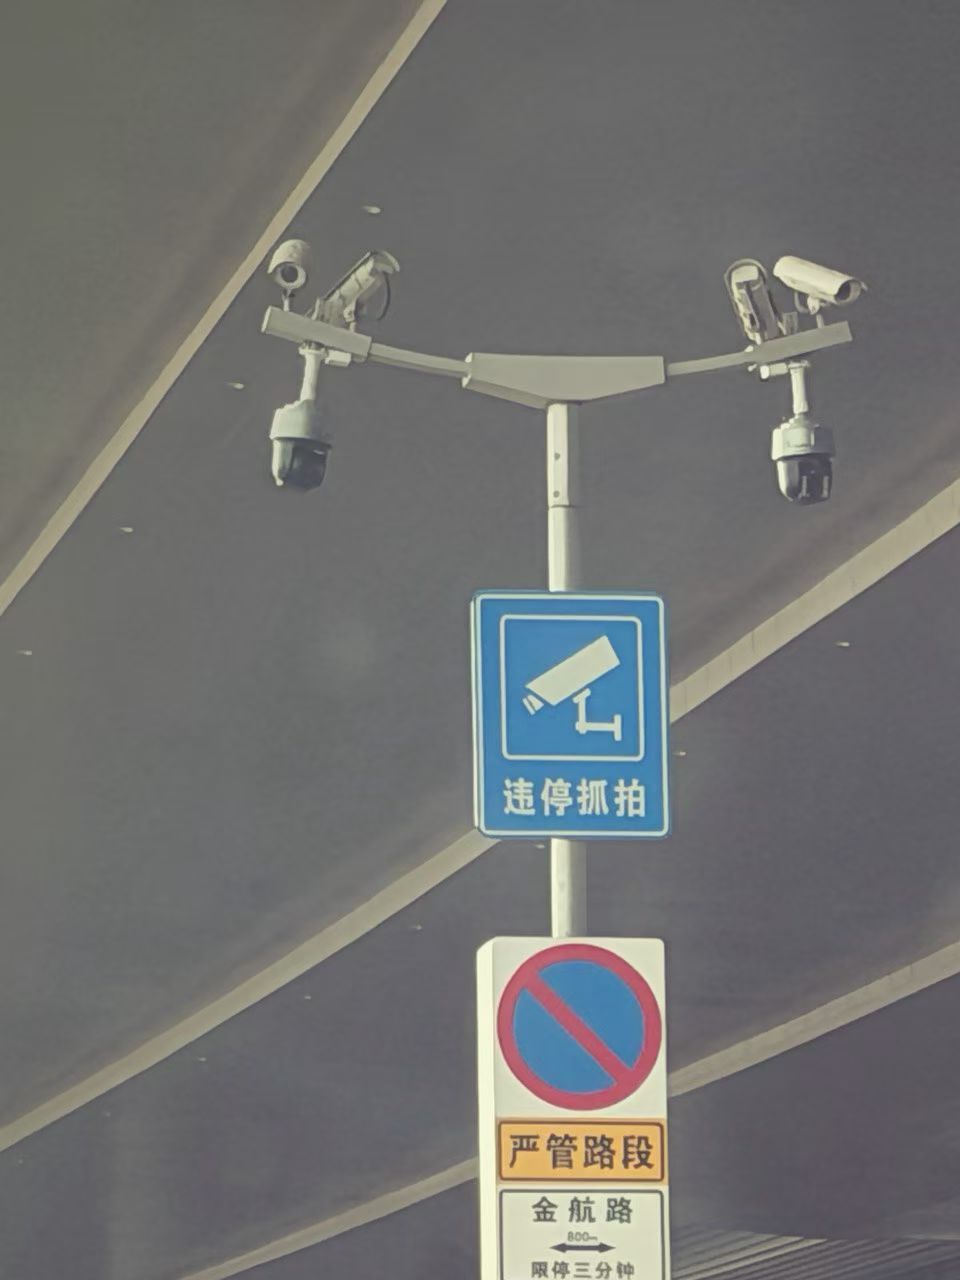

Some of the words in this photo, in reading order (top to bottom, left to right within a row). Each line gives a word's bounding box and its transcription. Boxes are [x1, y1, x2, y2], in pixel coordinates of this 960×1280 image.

[503, 777, 646, 817] 违停抓拍
[509, 1133, 654, 1170] 严管路段
[532, 1196, 633, 1223] 金航路
[531, 1261, 635, 1280] 限停三分钟
